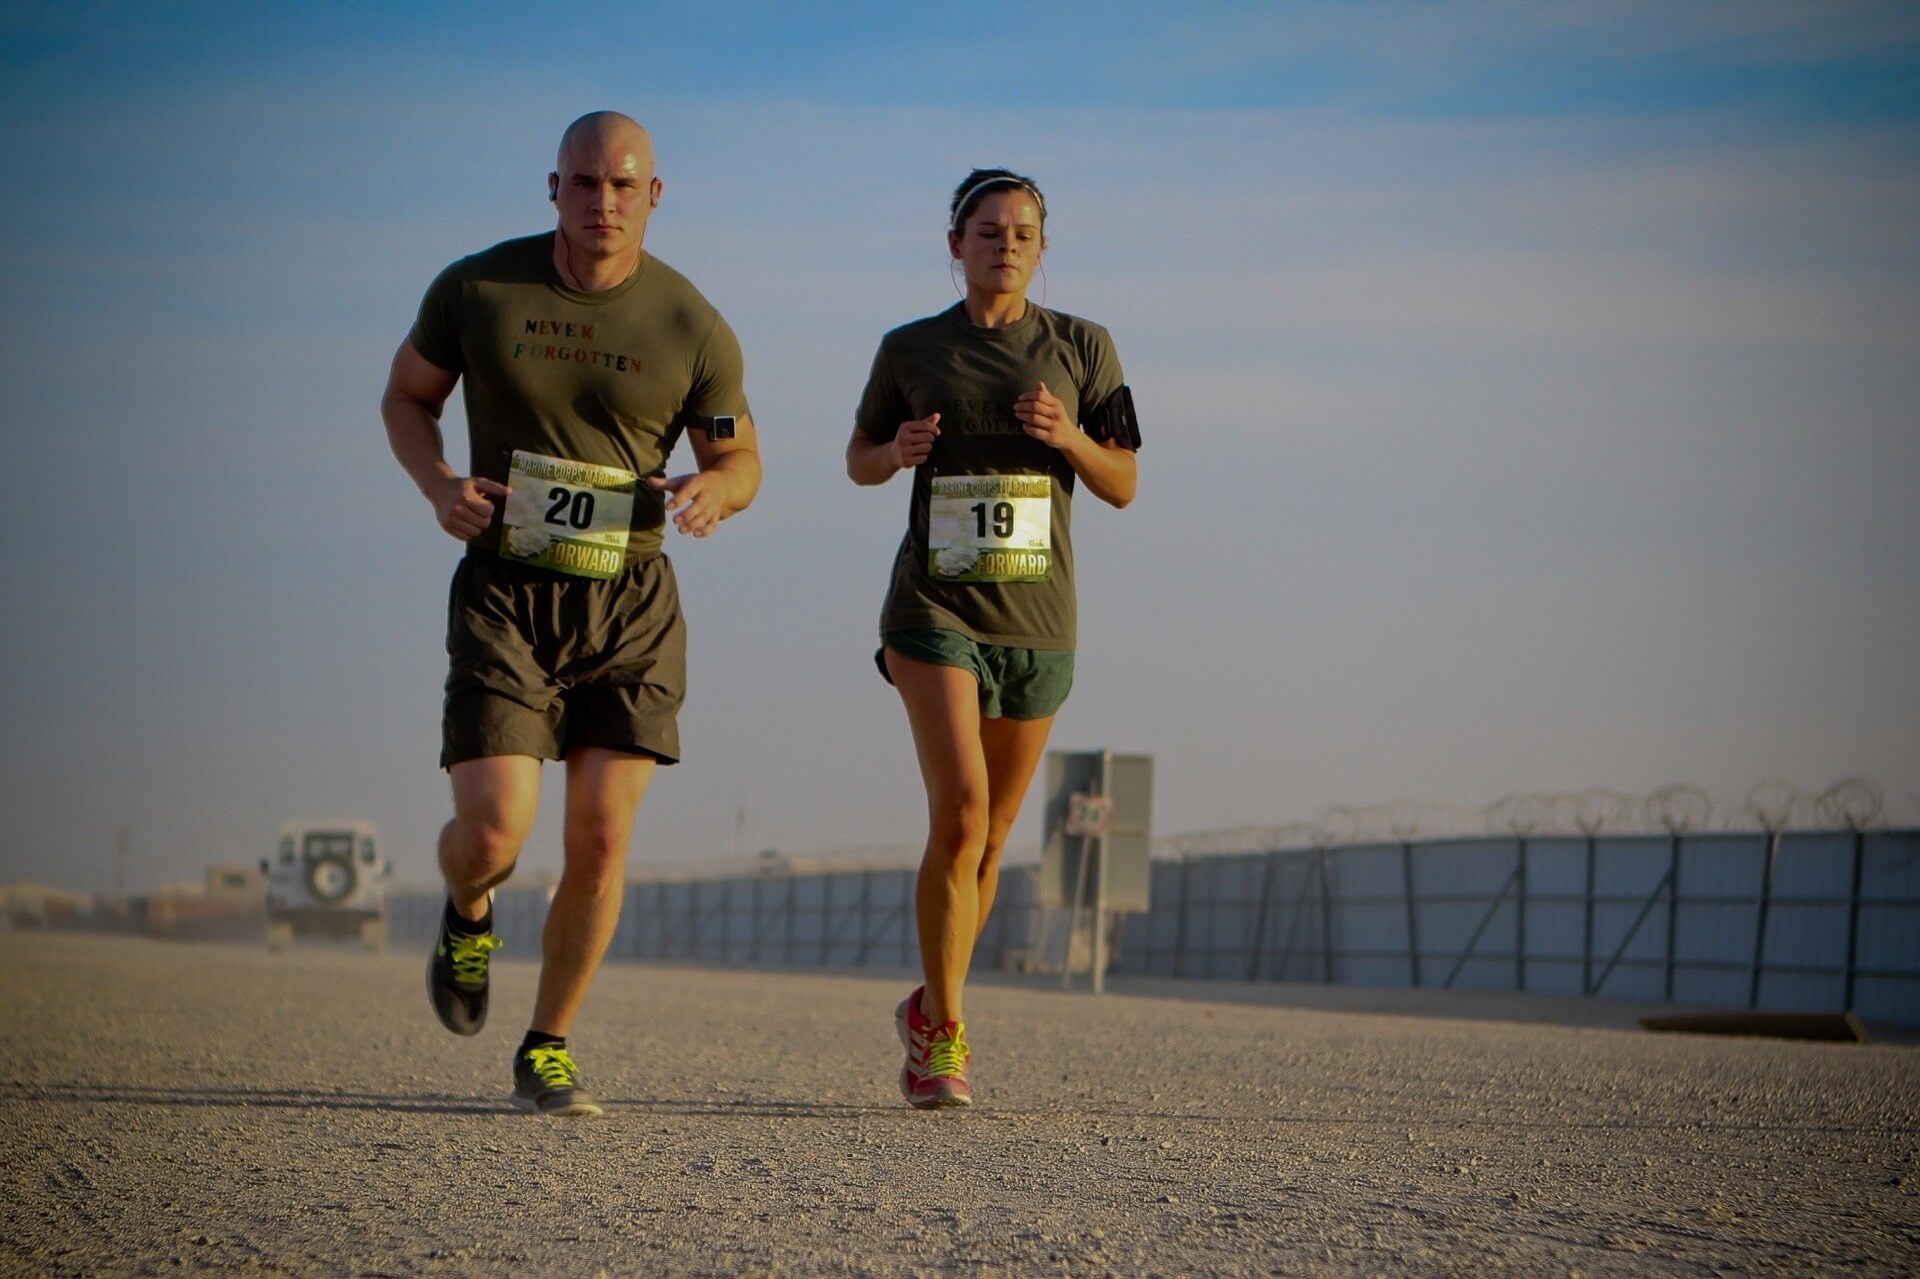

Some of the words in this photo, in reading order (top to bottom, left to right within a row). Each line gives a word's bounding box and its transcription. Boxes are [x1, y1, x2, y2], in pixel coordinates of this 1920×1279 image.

[525, 319, 594, 339] NEVER
[513, 343, 642, 373] FORGOTTEN
[518, 458, 552, 477] MARINE
[554, 465, 583, 482] CORPS
[972, 480, 998, 496] CORPS
[544, 486, 595, 530] 20
[971, 502, 1015, 539] 19
[547, 540, 619, 574] FORWARD
[977, 553, 1047, 576] FORWARD
